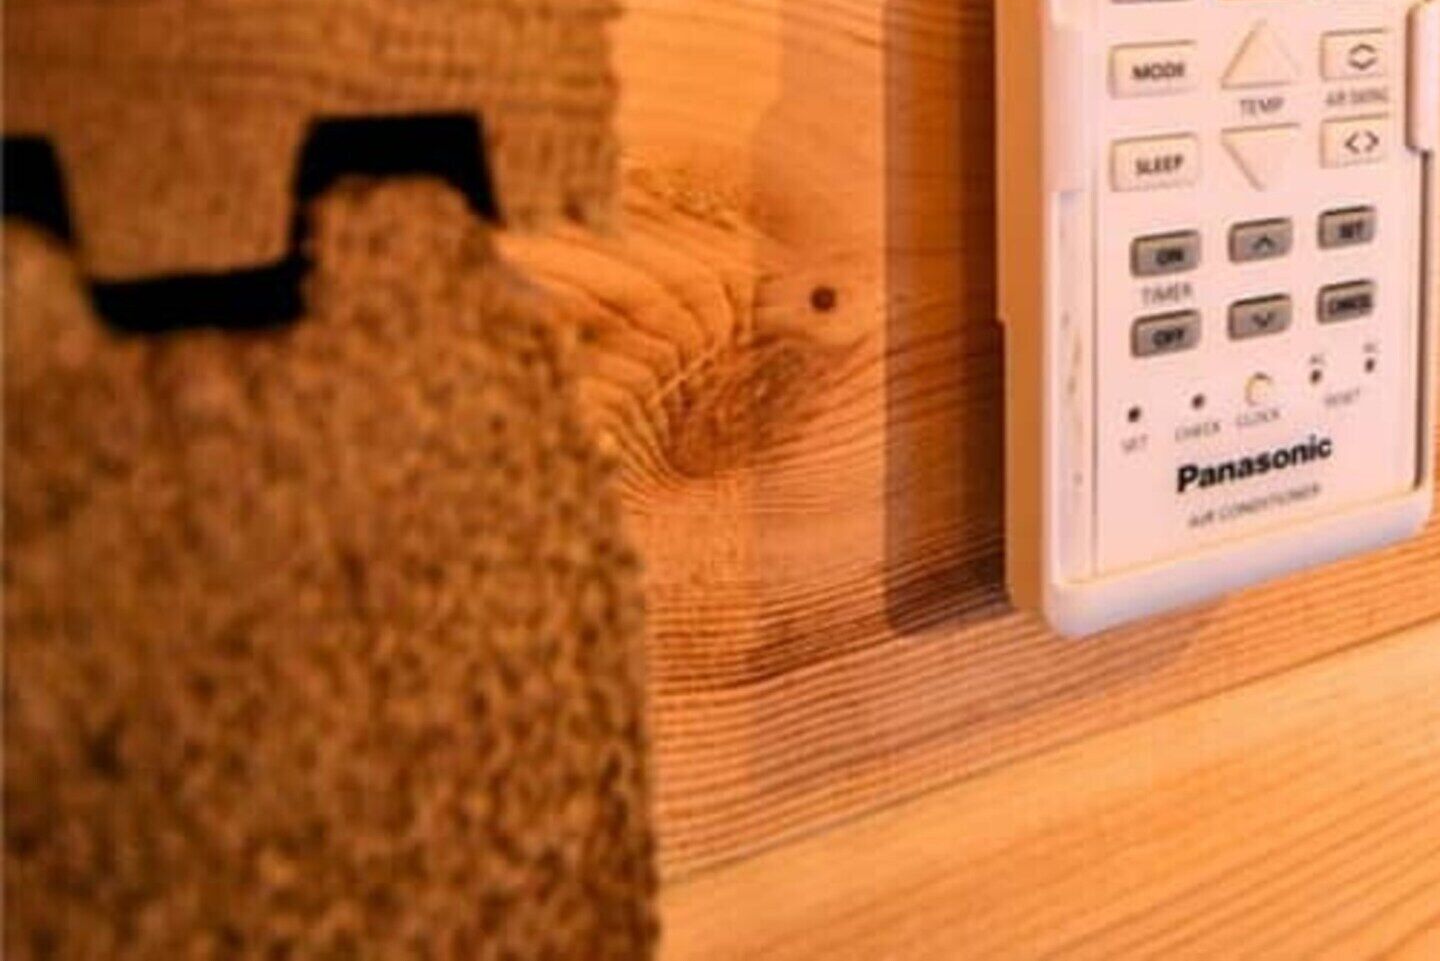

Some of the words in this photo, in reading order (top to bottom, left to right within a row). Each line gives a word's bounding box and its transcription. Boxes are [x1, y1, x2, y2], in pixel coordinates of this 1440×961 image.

[1132, 62, 1186, 80] MODE
[1240, 96, 1285, 116] TEMP
[1135, 154, 1184, 175] SLEEP
[1155, 247, 1184, 267] ON
[1140, 281, 1193, 306] TIMER
[1152, 327, 1186, 347] OFF
[1176, 433, 1334, 493] Panasonic
